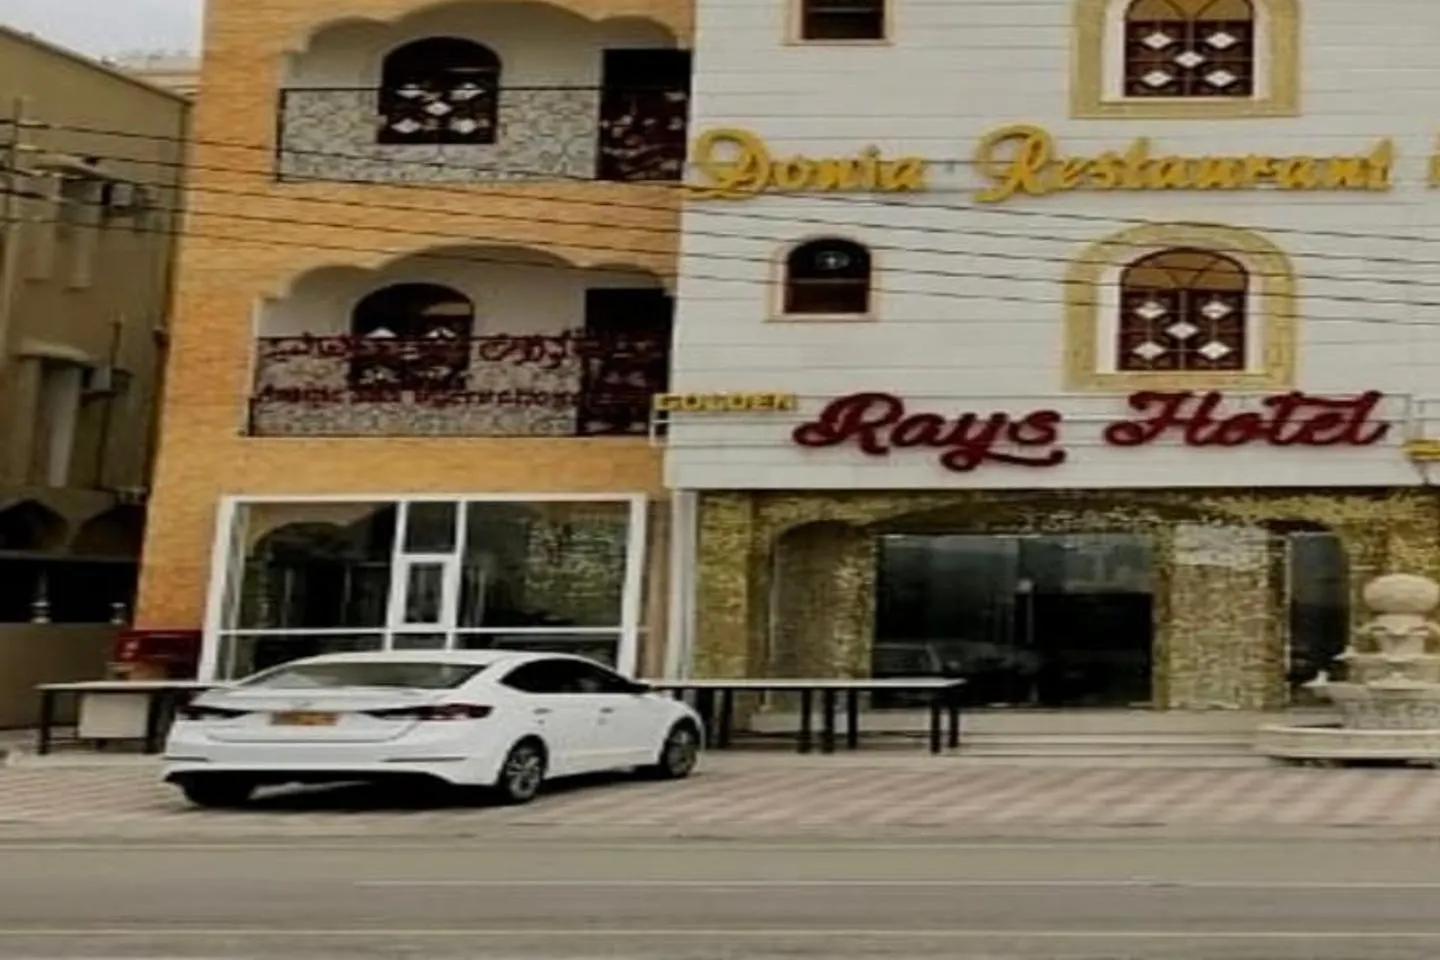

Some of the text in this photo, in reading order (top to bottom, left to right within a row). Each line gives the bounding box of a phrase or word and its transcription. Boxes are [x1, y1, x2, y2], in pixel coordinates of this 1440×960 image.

[683, 124, 1391, 202] Donia Restaurant
[793, 392, 1065, 471] Rays
[1105, 392, 1388, 445] Hotel
